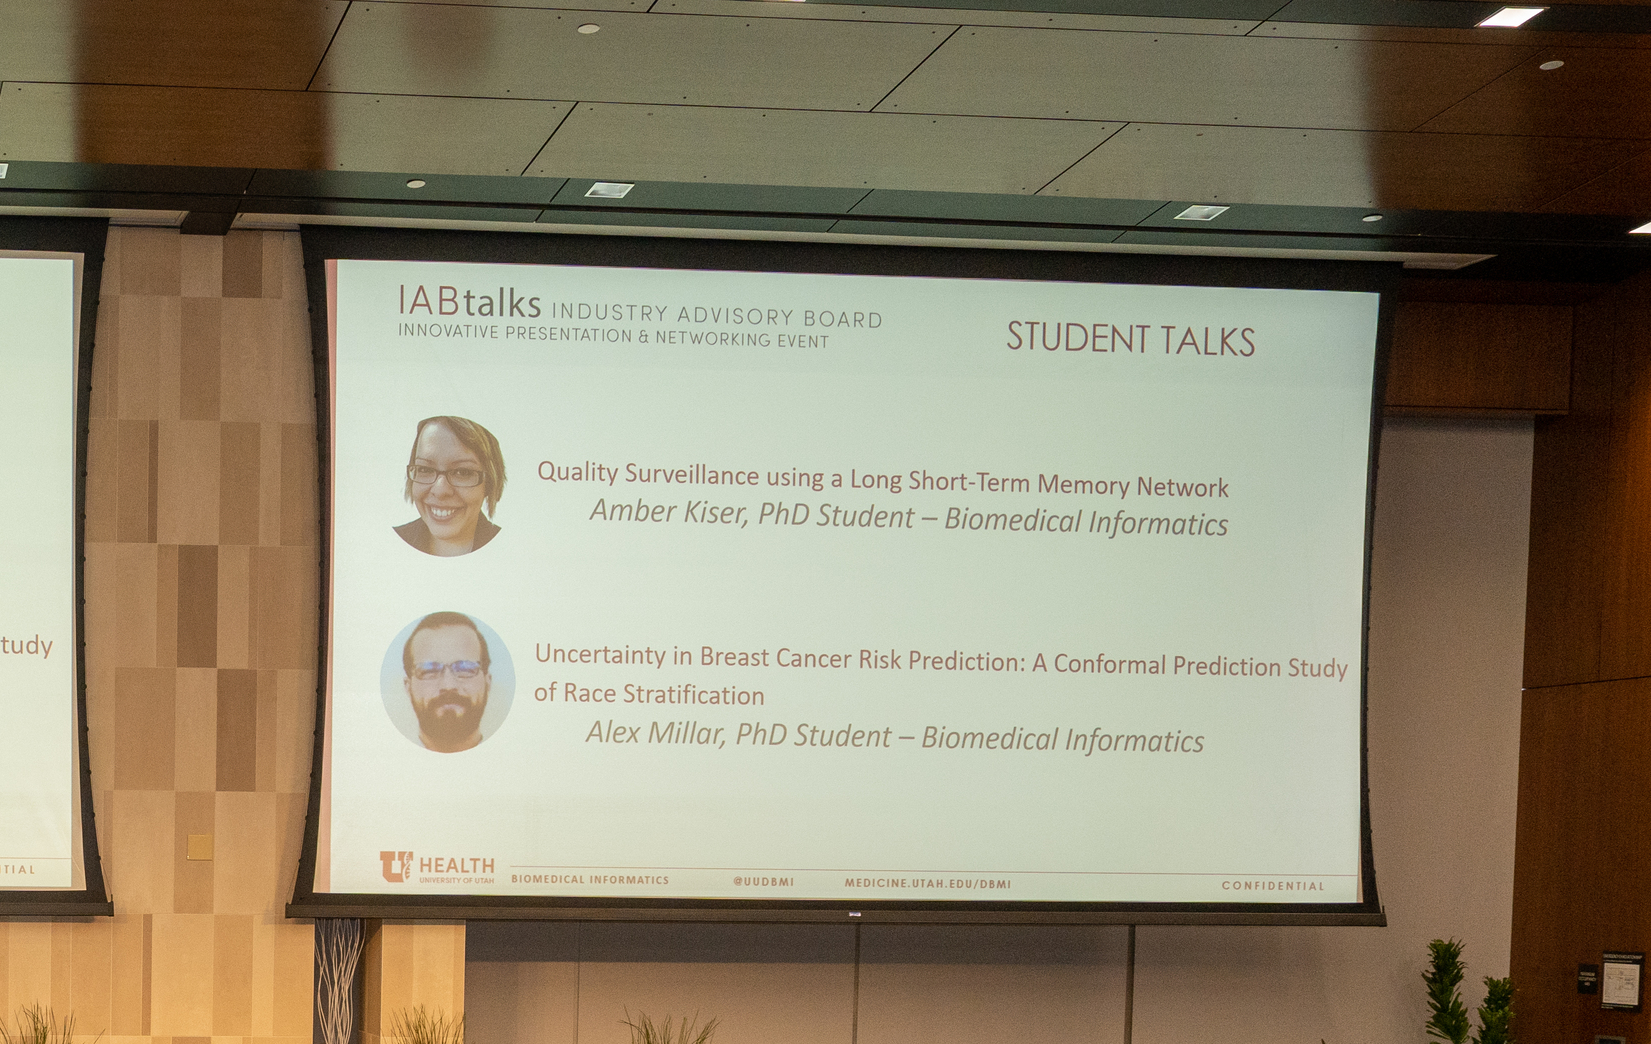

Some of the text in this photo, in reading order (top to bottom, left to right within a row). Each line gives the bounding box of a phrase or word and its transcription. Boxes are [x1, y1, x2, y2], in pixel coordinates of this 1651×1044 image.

[399, 284, 883, 329] IABtalks INDUSTRY ADVISORY BOARD
[398, 322, 830, 349] INNOVATIVE PRESENTATION & NETWORKING EVENT
[1006, 320, 1256, 358] STUDENT TALKS
[537, 460, 1229, 500] Quality Surveillance using a Long Short-Term Memory Network
[588, 497, 678, 523] Amber
[683, 500, 749, 529] Kiser,
[758, 501, 810, 526] PhD
[815, 502, 916, 529] Student
[944, 506, 1083, 533] Biomedical
[1088, 509, 1229, 539] Informatics
[535, 642, 1349, 683] Uncertainty in Breast Cancer Risk Prediction: A Conformal Prediction Study
[534, 680, 765, 706] of Race Stratification
[584, 719, 642, 744] Alex
[647, 720, 726, 750] Millar,
[735, 721, 788, 746] PhD
[793, 722, 893, 749] Student
[921, 725, 1060, 751] Biomedical
[1065, 726, 1205, 757] Informatics
[419, 857, 495, 874] HEALTH
[420, 876, 495, 886] UNIVERSITY OF UTAH
[511, 874, 669, 886] BIOMEDICAL INFORMATICS
[733, 876, 794, 887] @UUDBMI
[844, 877, 1011, 890] MEDICINE.UTAH.EDU/DBMI
[1221, 880, 1324, 892] CONFIDENTIAL
